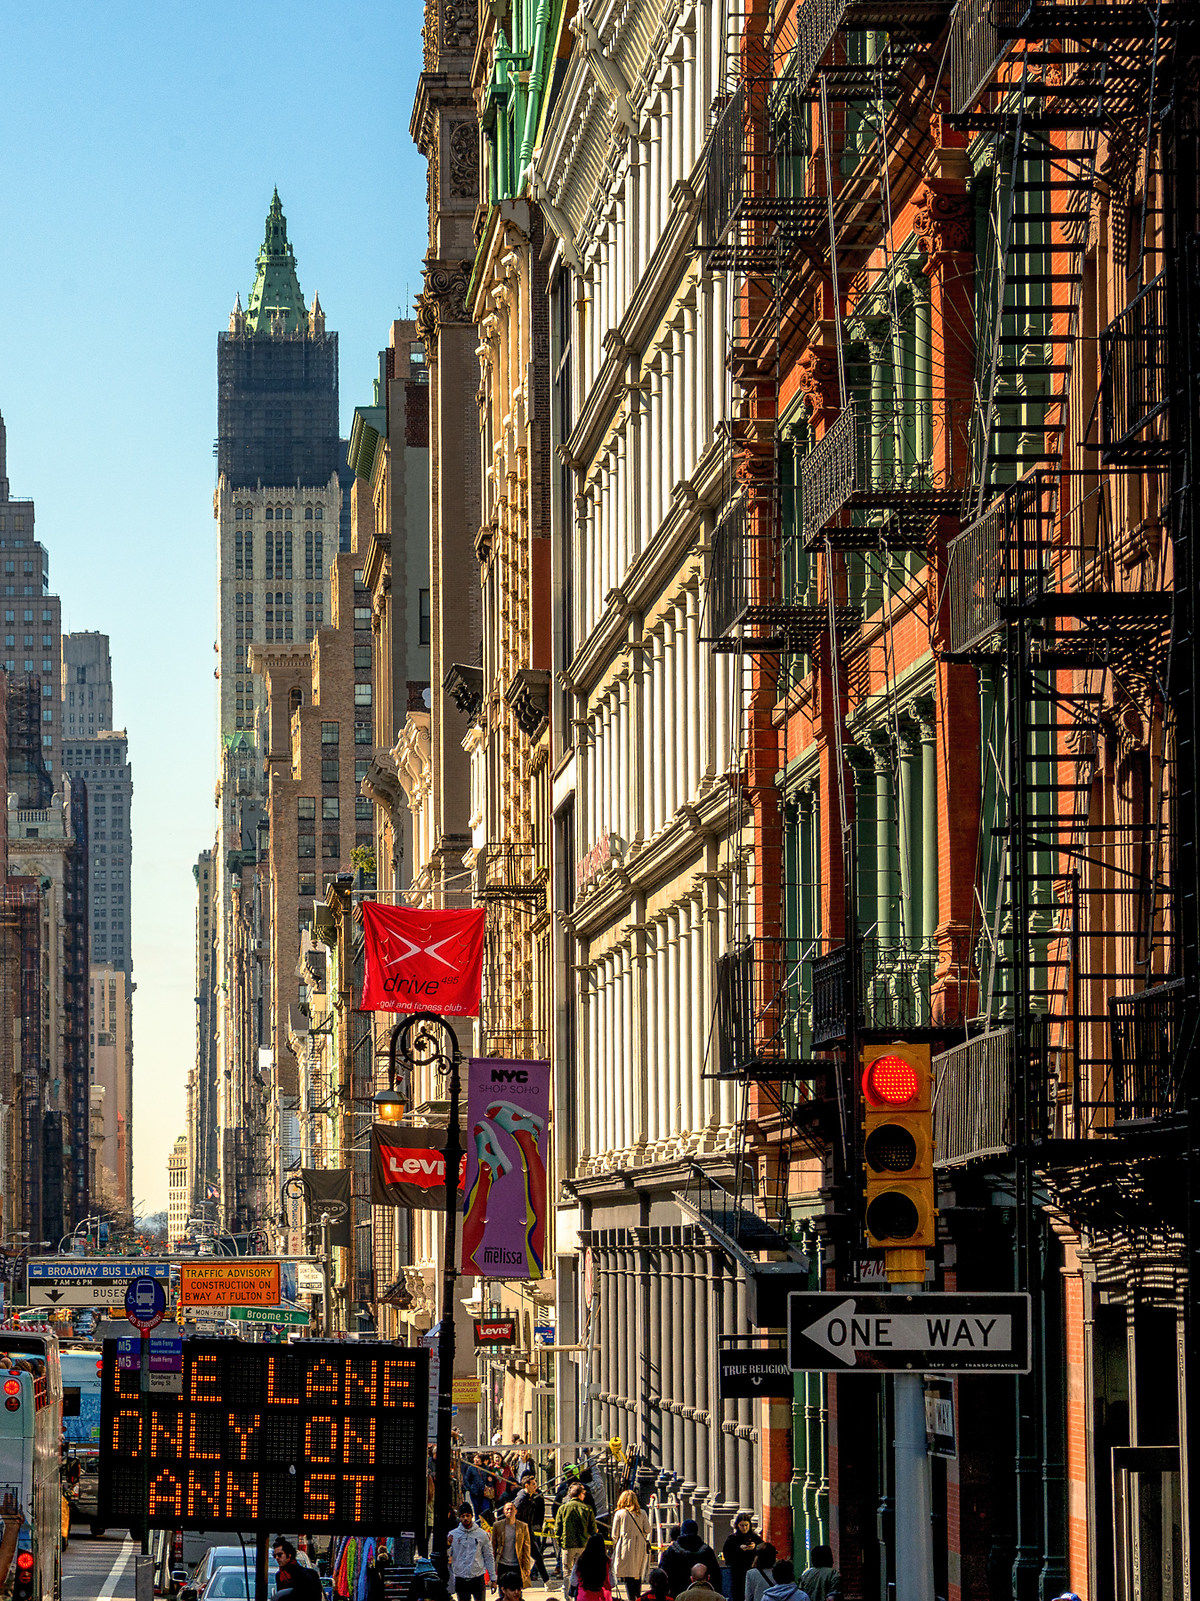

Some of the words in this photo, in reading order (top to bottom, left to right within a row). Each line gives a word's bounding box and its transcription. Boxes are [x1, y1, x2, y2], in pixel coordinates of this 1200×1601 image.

[383, 973, 439, 995] drive
[441, 976, 459, 984] 495
[396, 1001, 412, 1010] and
[414, 1002, 442, 1011] fitness
[491, 1069, 528, 1083] NYC
[479, 1084, 507, 1093] SHOP
[510, 1085, 539, 1094] SOHO
[484, 1247, 522, 1264] melissa
[47, 1267, 99, 1276] BROADWAY
[102, 1267, 121, 1276] BUS
[125, 1267, 150, 1276] LANE
[186, 1269, 224, 1277] TRAFFIC
[227, 1269, 273, 1277] ADVISORY
[191, 1281, 256, 1289] CONSTRUCTION
[259, 1281, 271, 1289] ON
[93, 1289, 125, 1297] BUSES
[185, 1292, 211, 1300] B'WAY
[216, 1292, 226, 1300] AT
[230, 1292, 262, 1300] FULTON
[266, 1292, 276, 1300] ST
[247, 1310, 280, 1320] Broome
[284, 1312, 293, 1321] St
[827, 1318, 893, 1347] ONE
[926, 1318, 997, 1347] WAY
[118, 1340, 131, 1351] M5
[118, 1356, 131, 1367] M5
[723, 1364, 747, 1376] TRUE
[749, 1364, 790, 1376] RELIGION
[268, 1358, 416, 1408] LANE
[113, 1411, 260, 1460] ONLY
[304, 1416, 376, 1464] ON
[149, 1469, 258, 1518] ANN
[303, 1474, 375, 1522] ST
